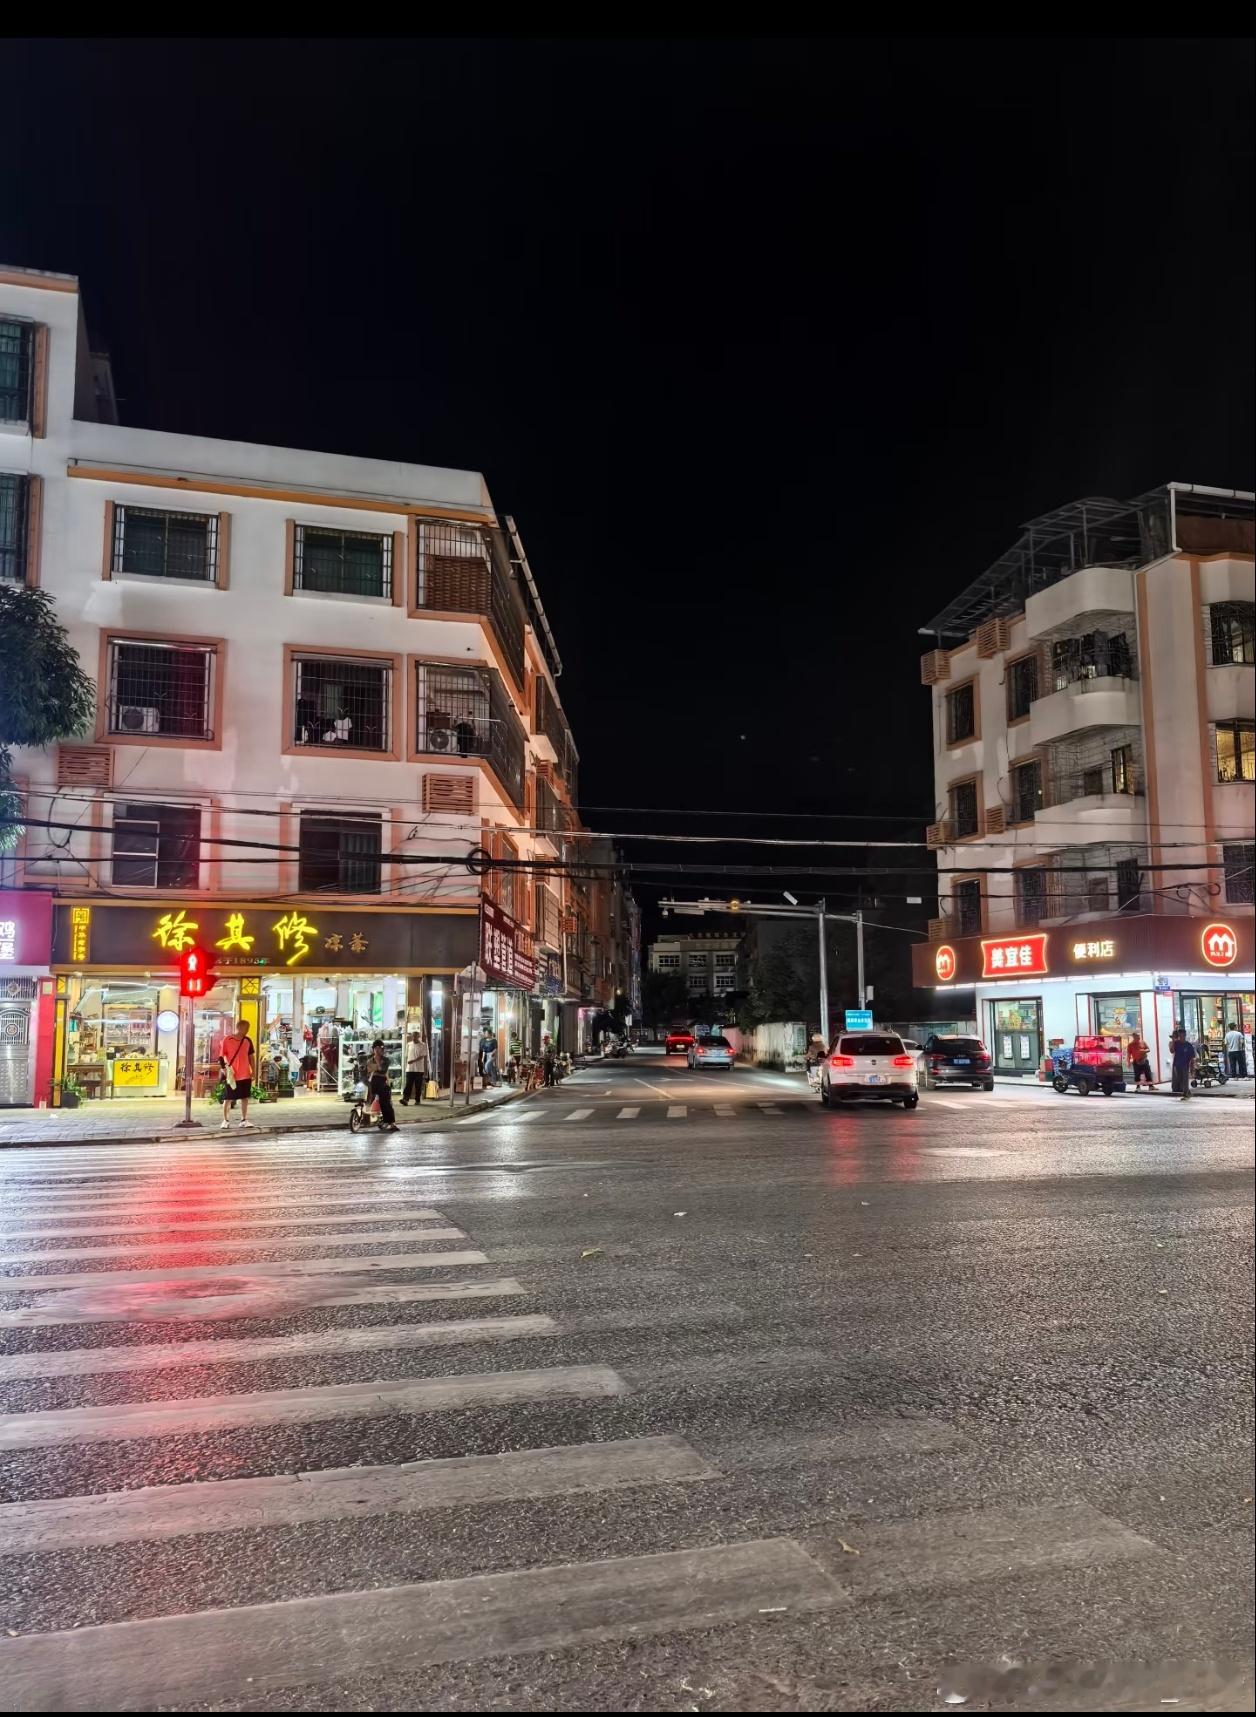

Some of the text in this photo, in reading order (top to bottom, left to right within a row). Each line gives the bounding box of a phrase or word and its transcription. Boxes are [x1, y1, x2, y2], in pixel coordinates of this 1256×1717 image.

[152, 910, 318, 966] 徐其修
[1073, 940, 1116, 960] 便利店
[991, 944, 1033, 969] 美宜佳
